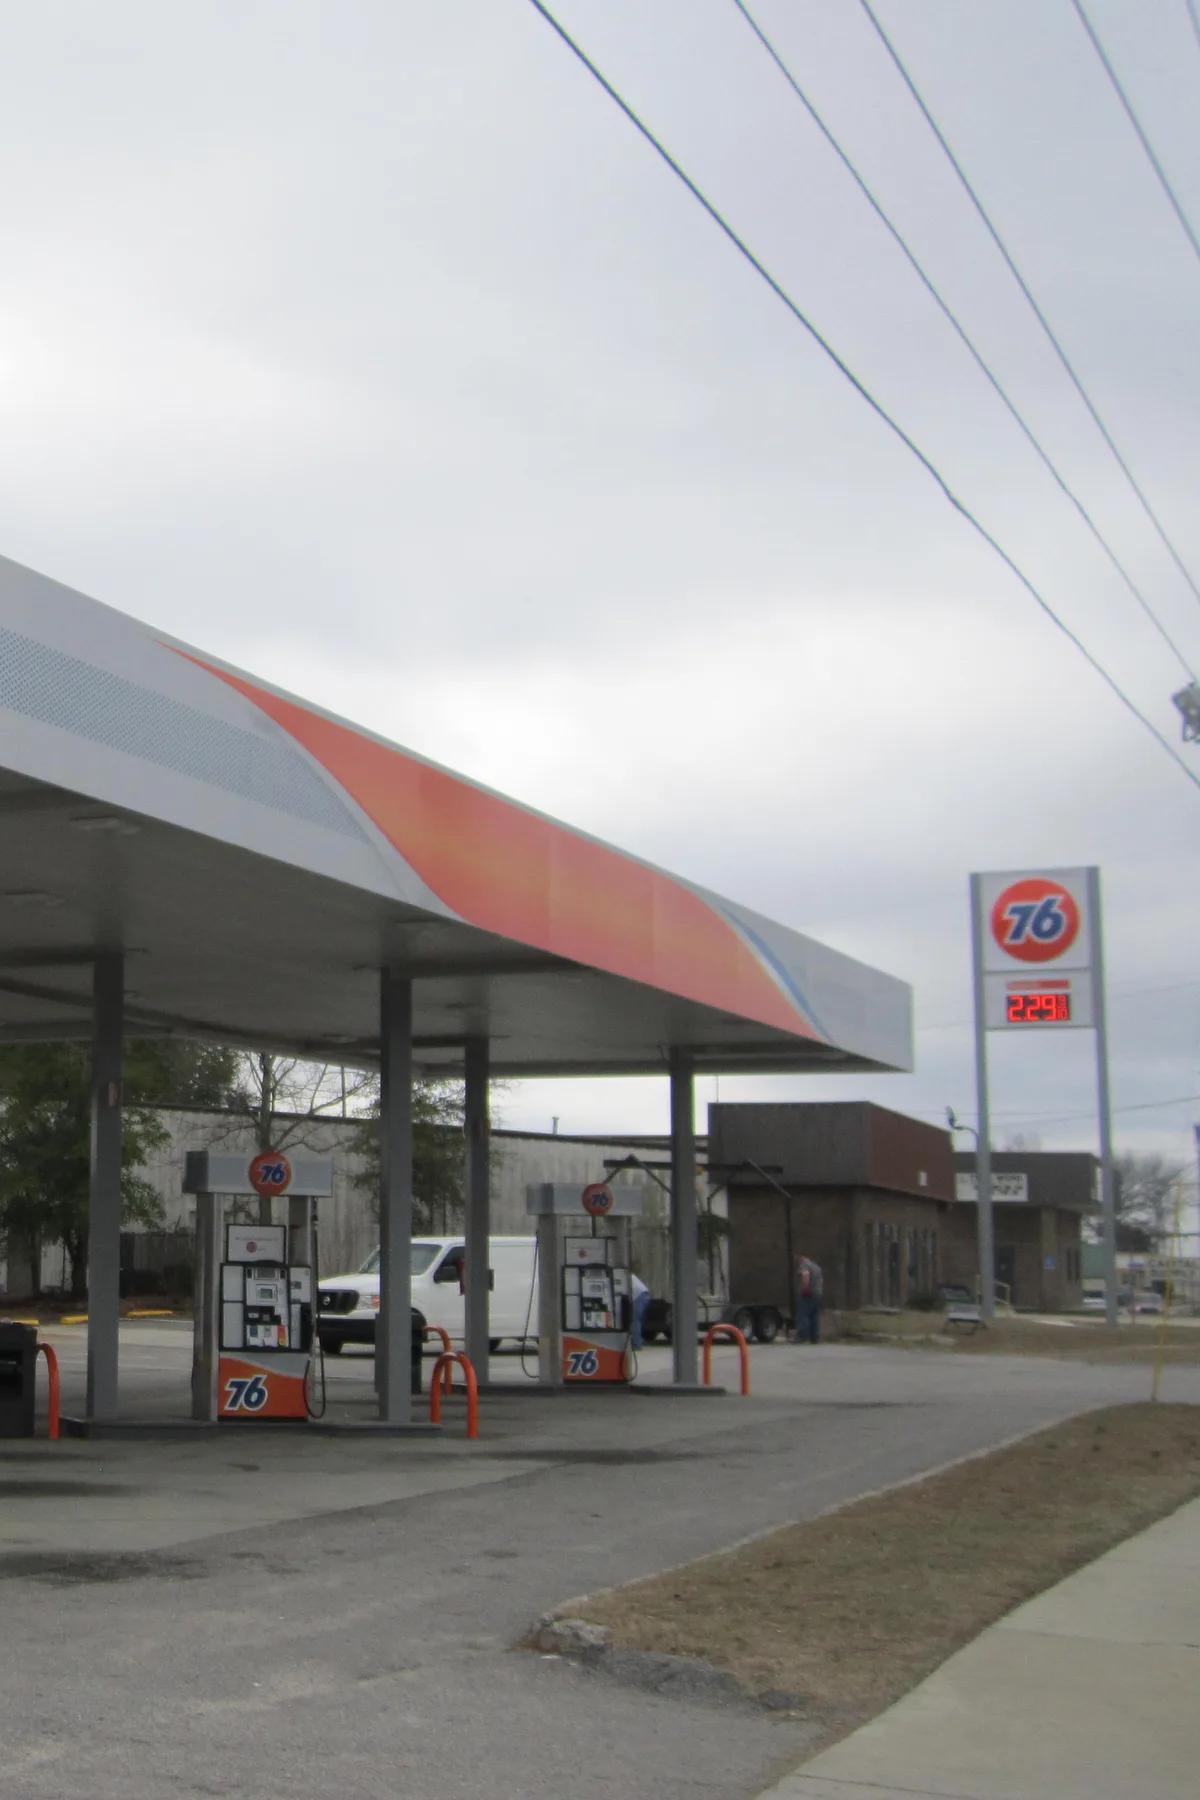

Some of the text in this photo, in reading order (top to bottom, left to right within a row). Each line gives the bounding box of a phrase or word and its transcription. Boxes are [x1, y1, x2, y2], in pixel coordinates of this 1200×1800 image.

[1002, 894, 1068, 944] 76
[256, 1163, 286, 1184] 76
[591, 1192, 609, 1207] 76
[567, 1350, 598, 1376] 76
[223, 1374, 268, 1411] 76
